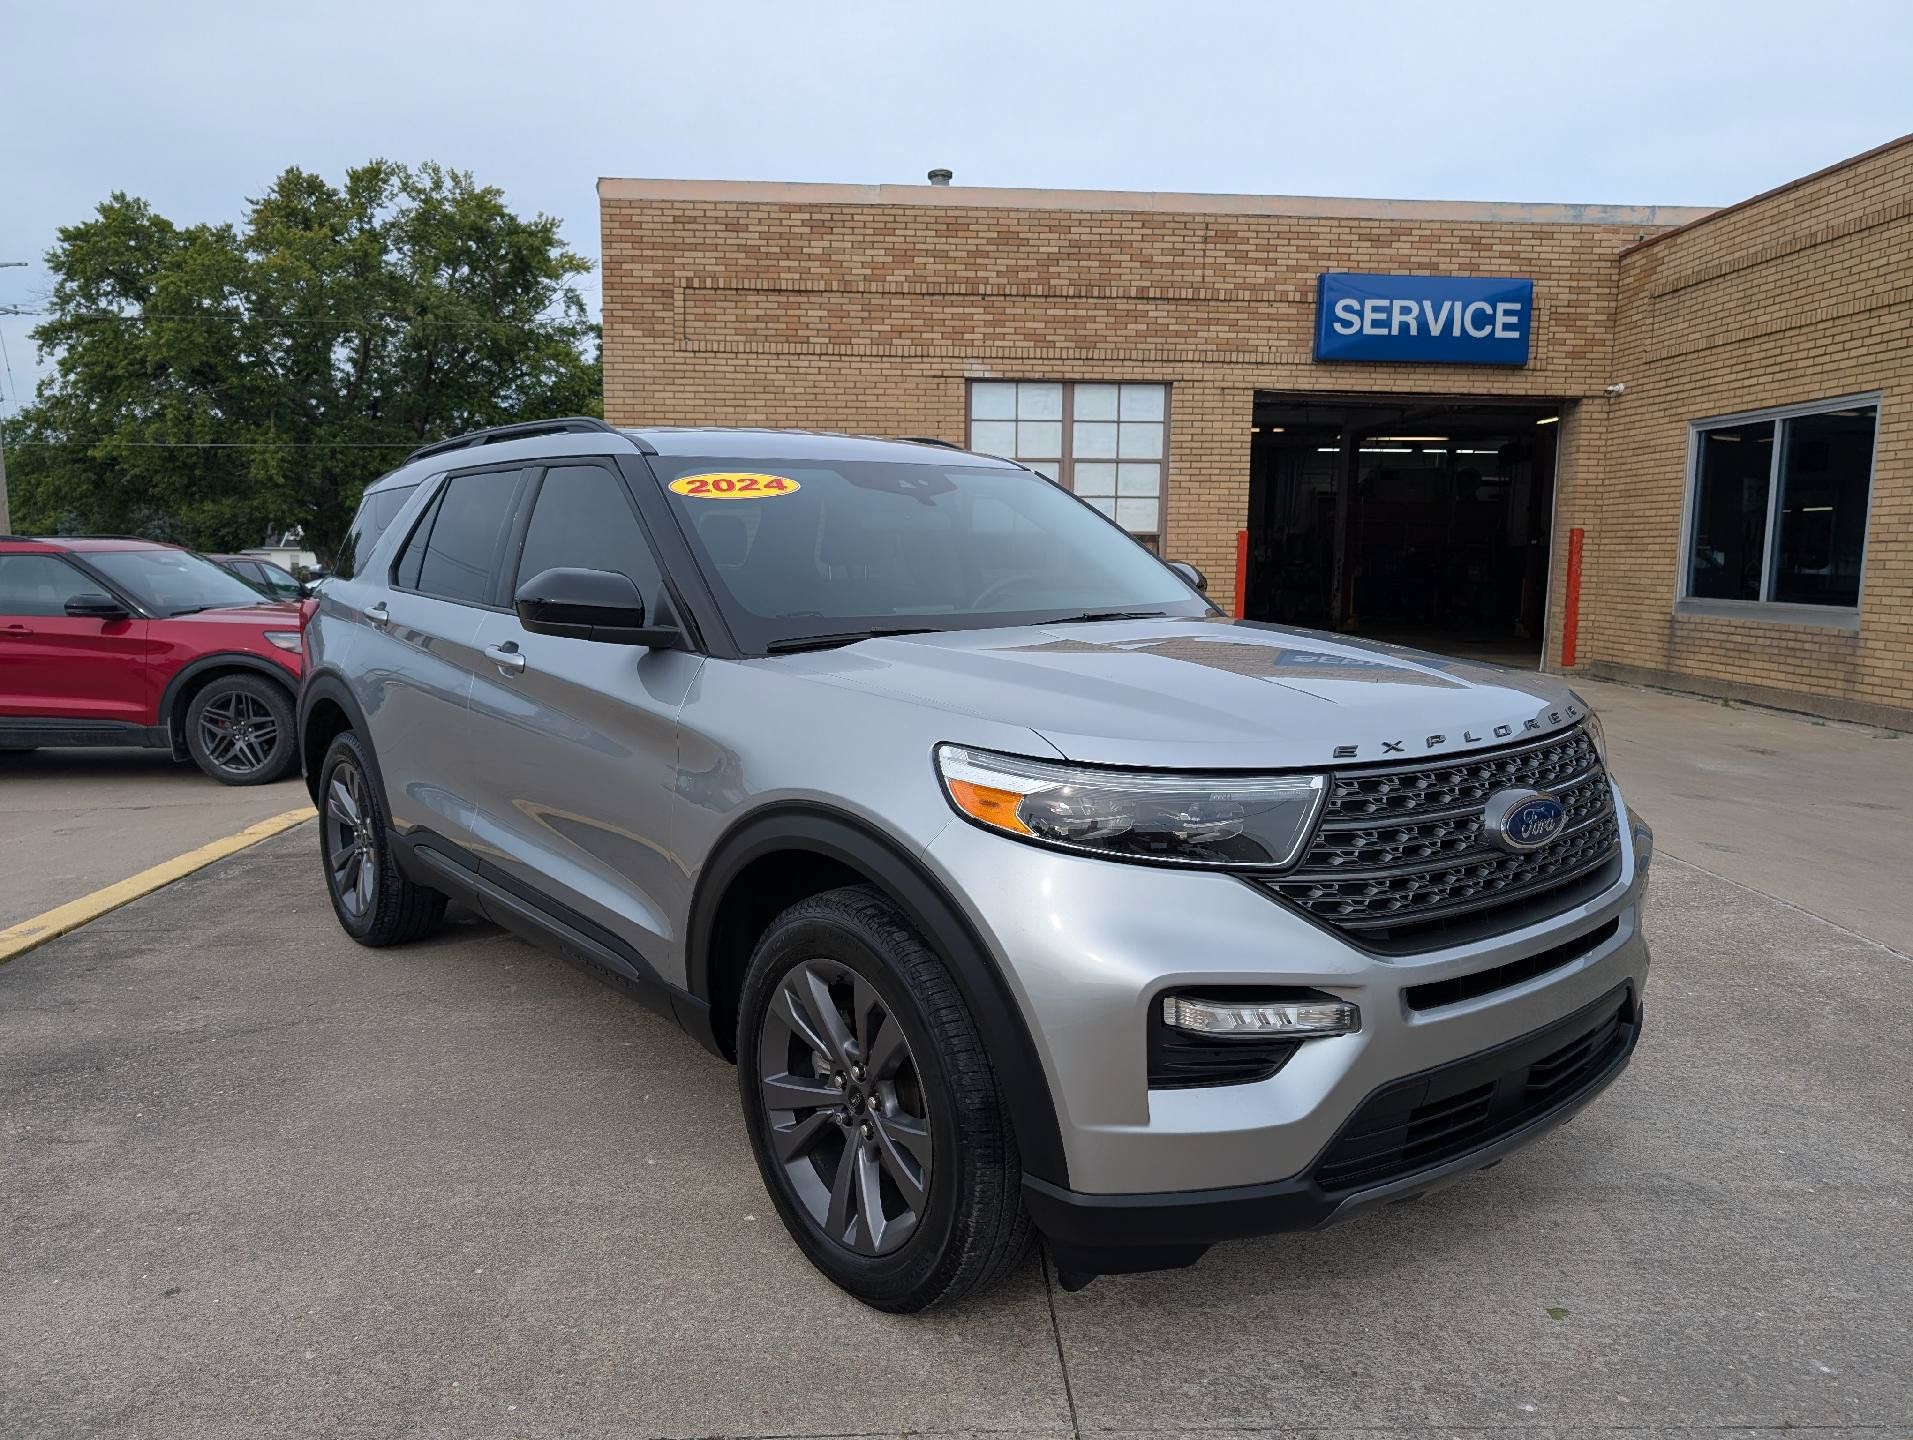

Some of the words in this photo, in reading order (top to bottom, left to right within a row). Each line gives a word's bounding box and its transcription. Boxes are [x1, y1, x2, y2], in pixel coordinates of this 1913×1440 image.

[1333, 298, 1522, 339] SERVICE
[686, 478, 787, 494] 2024
[1332, 704, 1578, 759] EXPLORER
[1522, 806, 1556, 839] Ford
